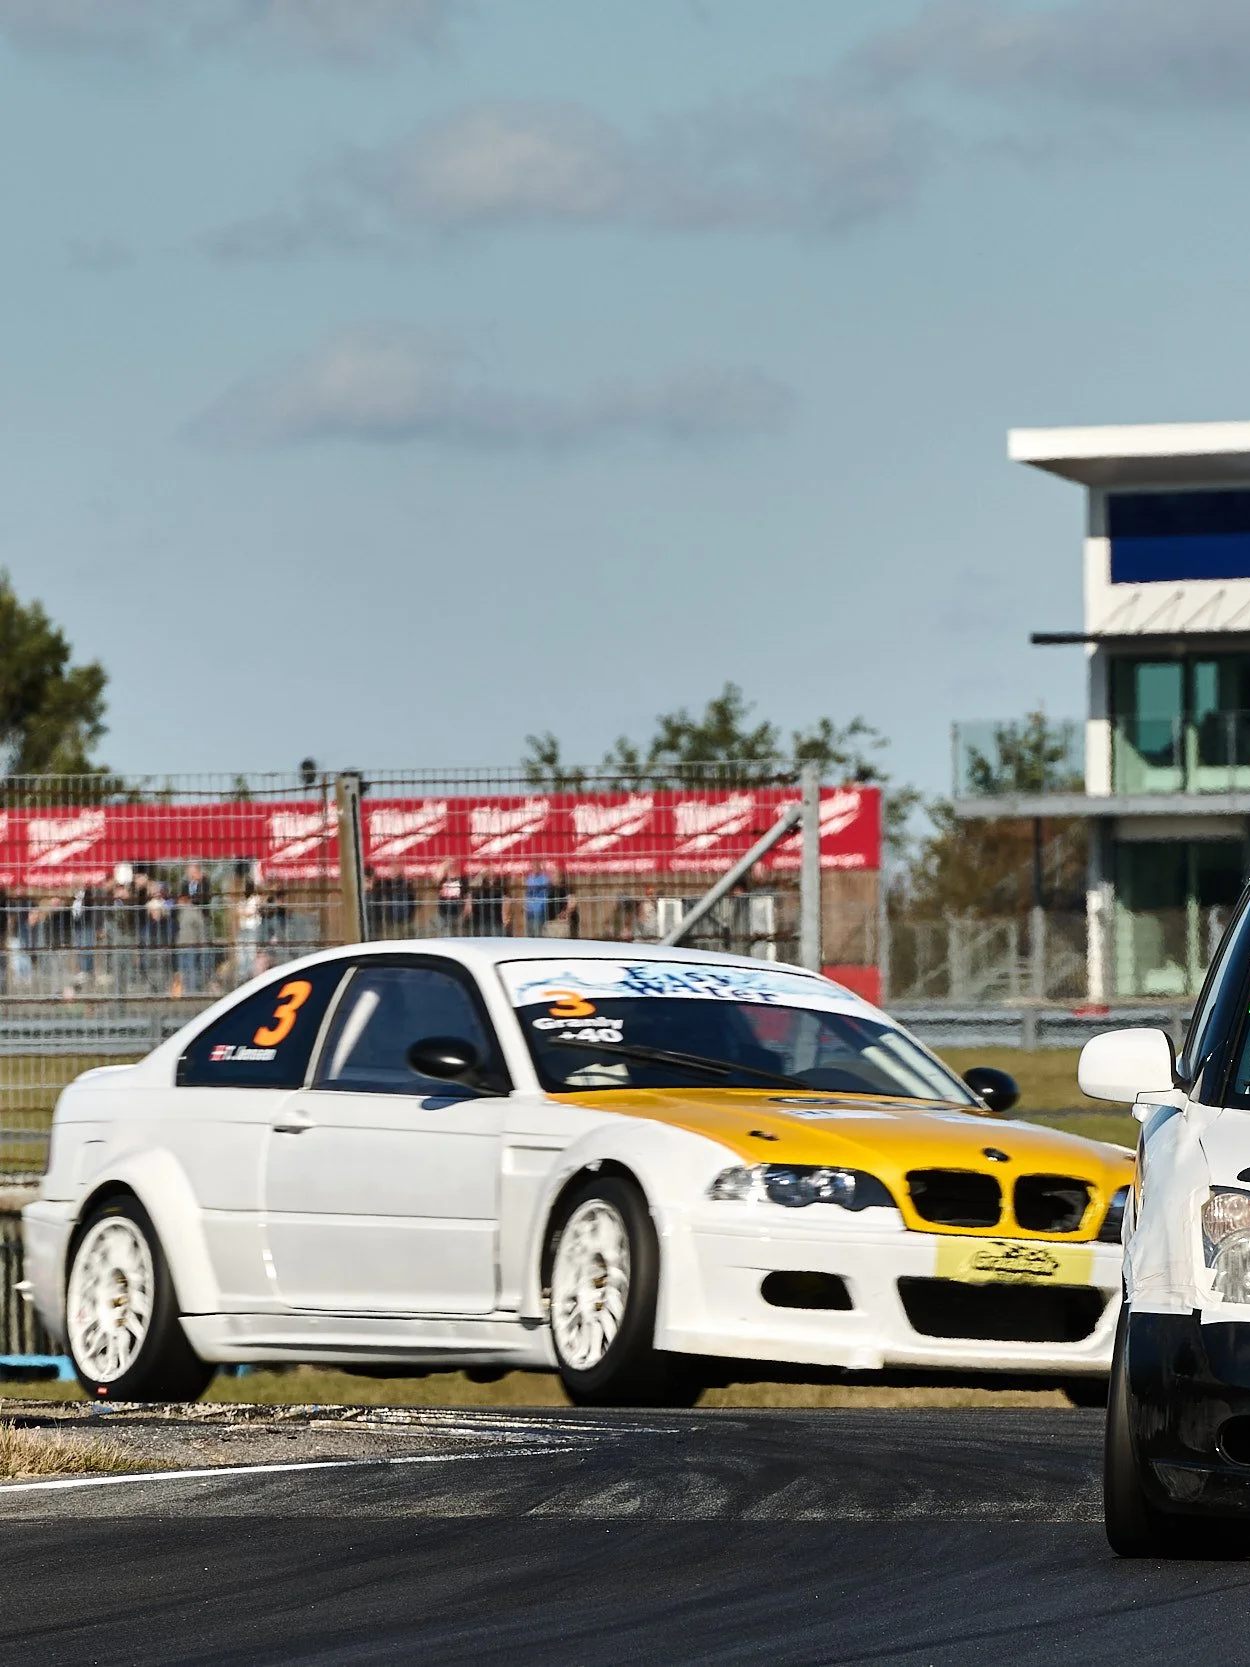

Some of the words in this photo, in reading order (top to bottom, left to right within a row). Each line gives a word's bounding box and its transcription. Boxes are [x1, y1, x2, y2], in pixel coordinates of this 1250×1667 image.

[253, 980, 313, 1047] 3
[543, 990, 597, 1018] 3
[557, 1028, 624, 1043] +40
